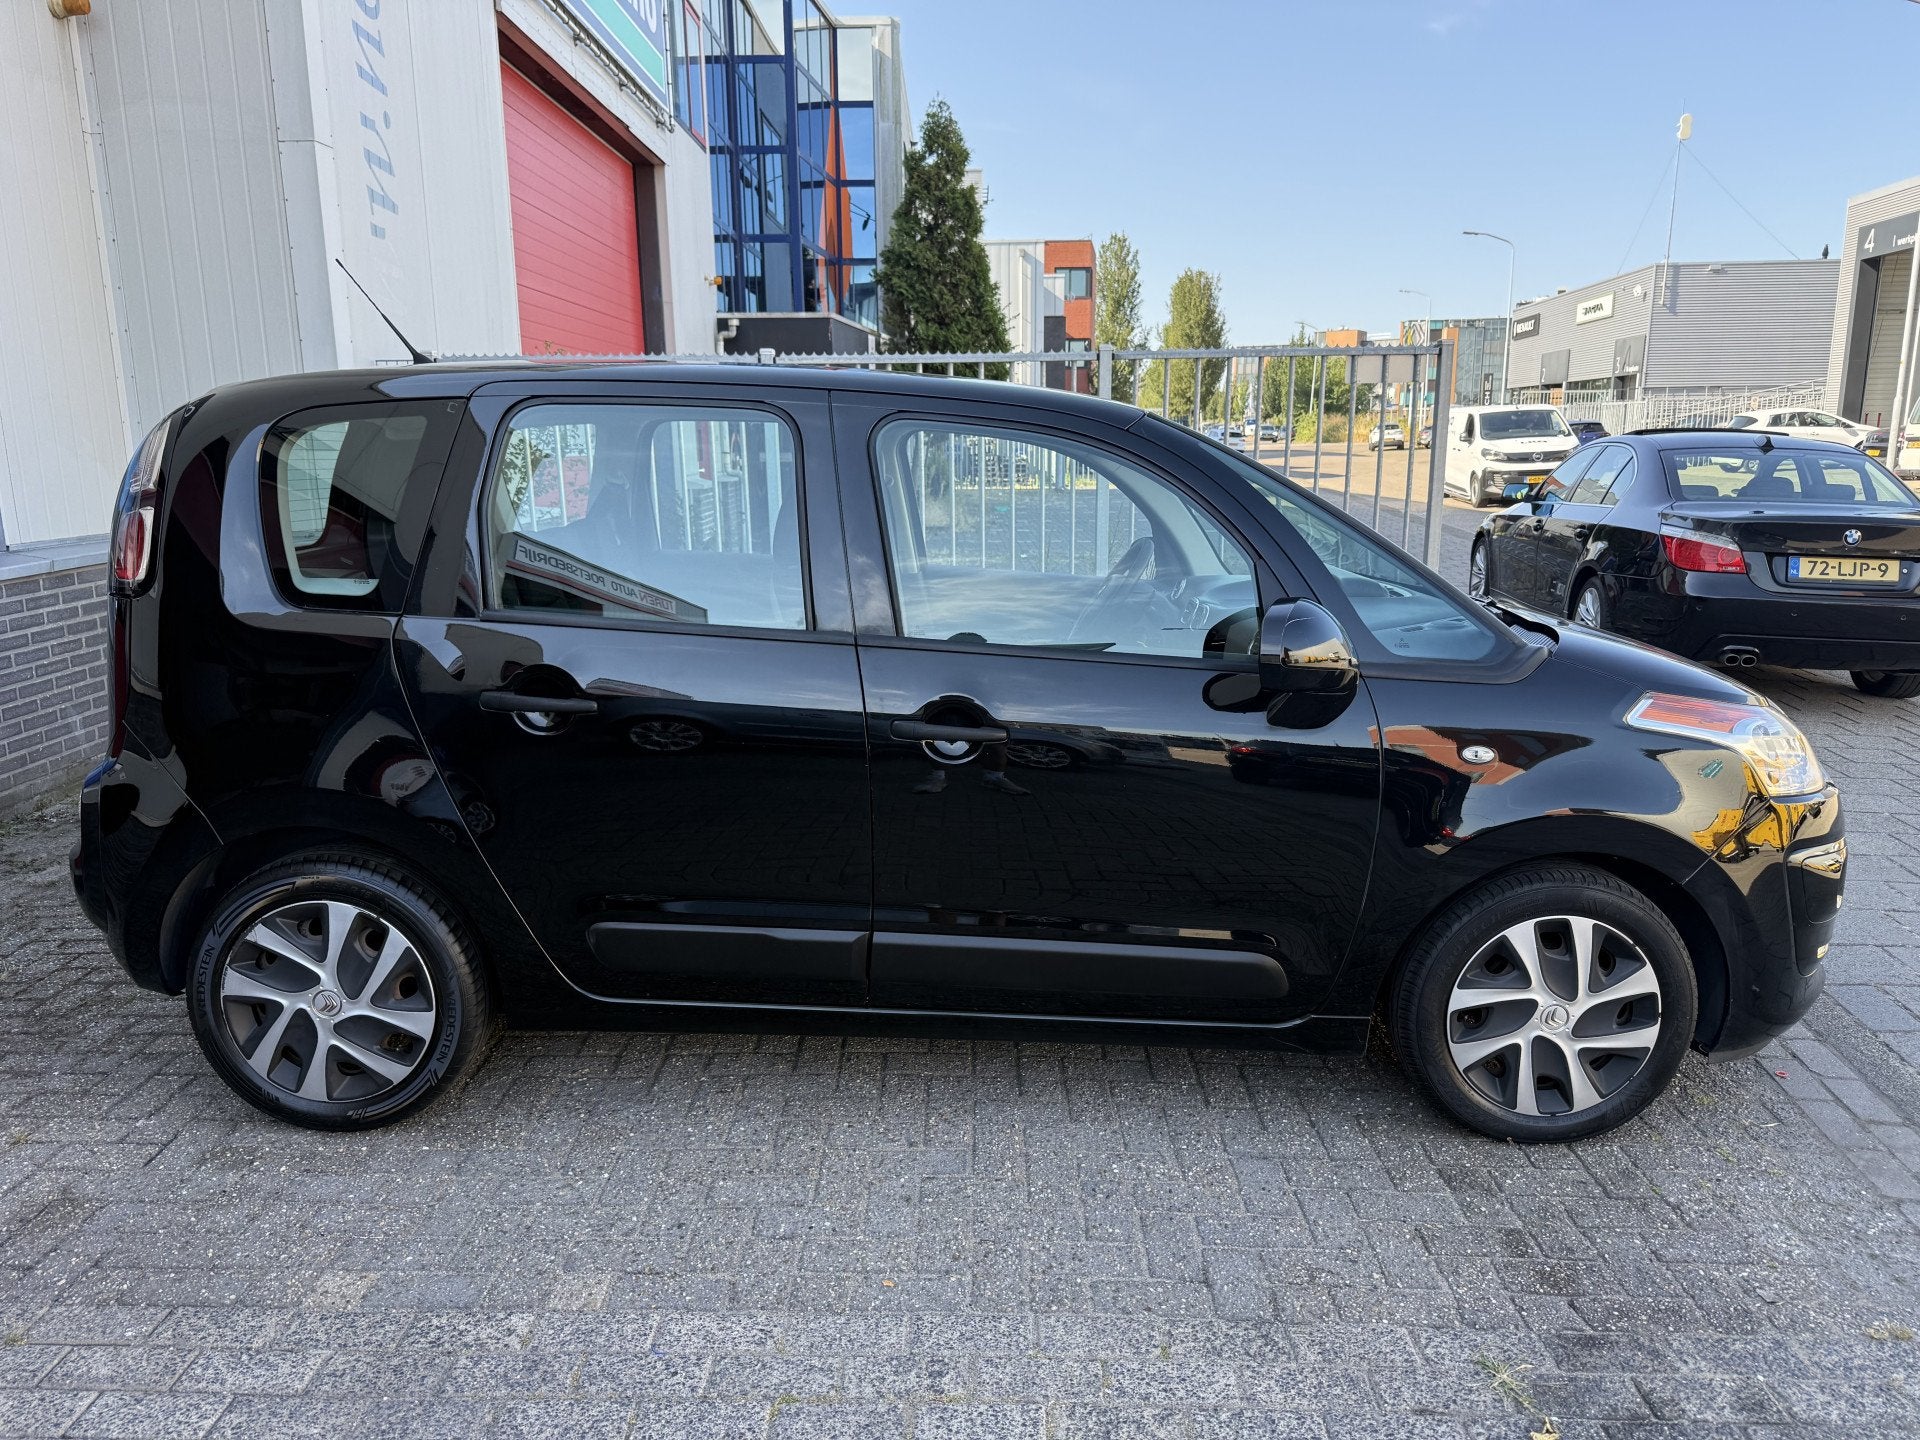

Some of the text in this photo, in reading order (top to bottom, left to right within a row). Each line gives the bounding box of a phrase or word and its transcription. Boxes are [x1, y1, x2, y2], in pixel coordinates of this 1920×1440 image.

[1864, 228, 1875, 253] 4
[1615, 356, 1621, 374] 3
[1541, 368, 1546, 383] 2
[1807, 560, 1889, 578] 72-LJP-9
